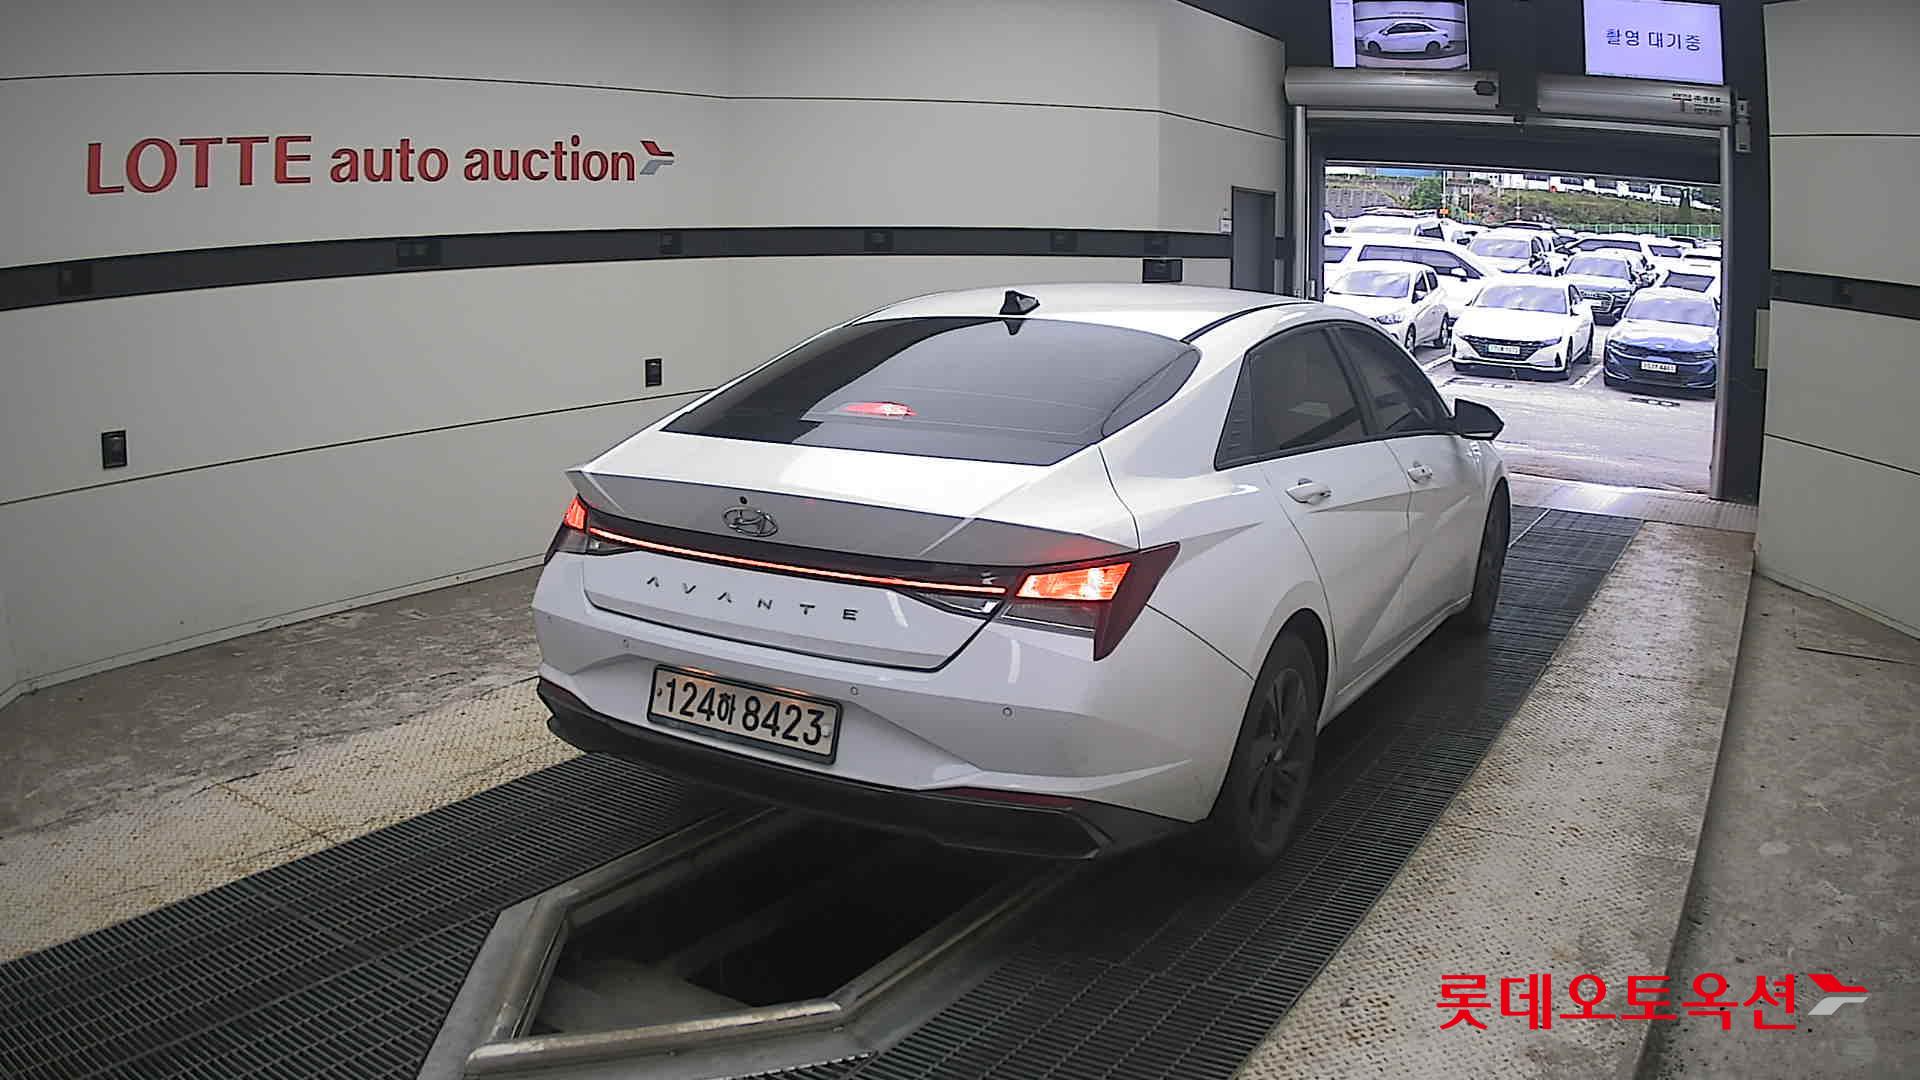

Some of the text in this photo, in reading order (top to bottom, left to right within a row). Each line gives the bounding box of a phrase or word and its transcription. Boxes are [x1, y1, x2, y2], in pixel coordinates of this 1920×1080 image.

[1648, 31, 1701, 52] 대기중
[87, 134, 636, 195] LOTTE auto auction
[646, 575, 859, 621] AVANTE
[741, 696, 824, 746] 8423
